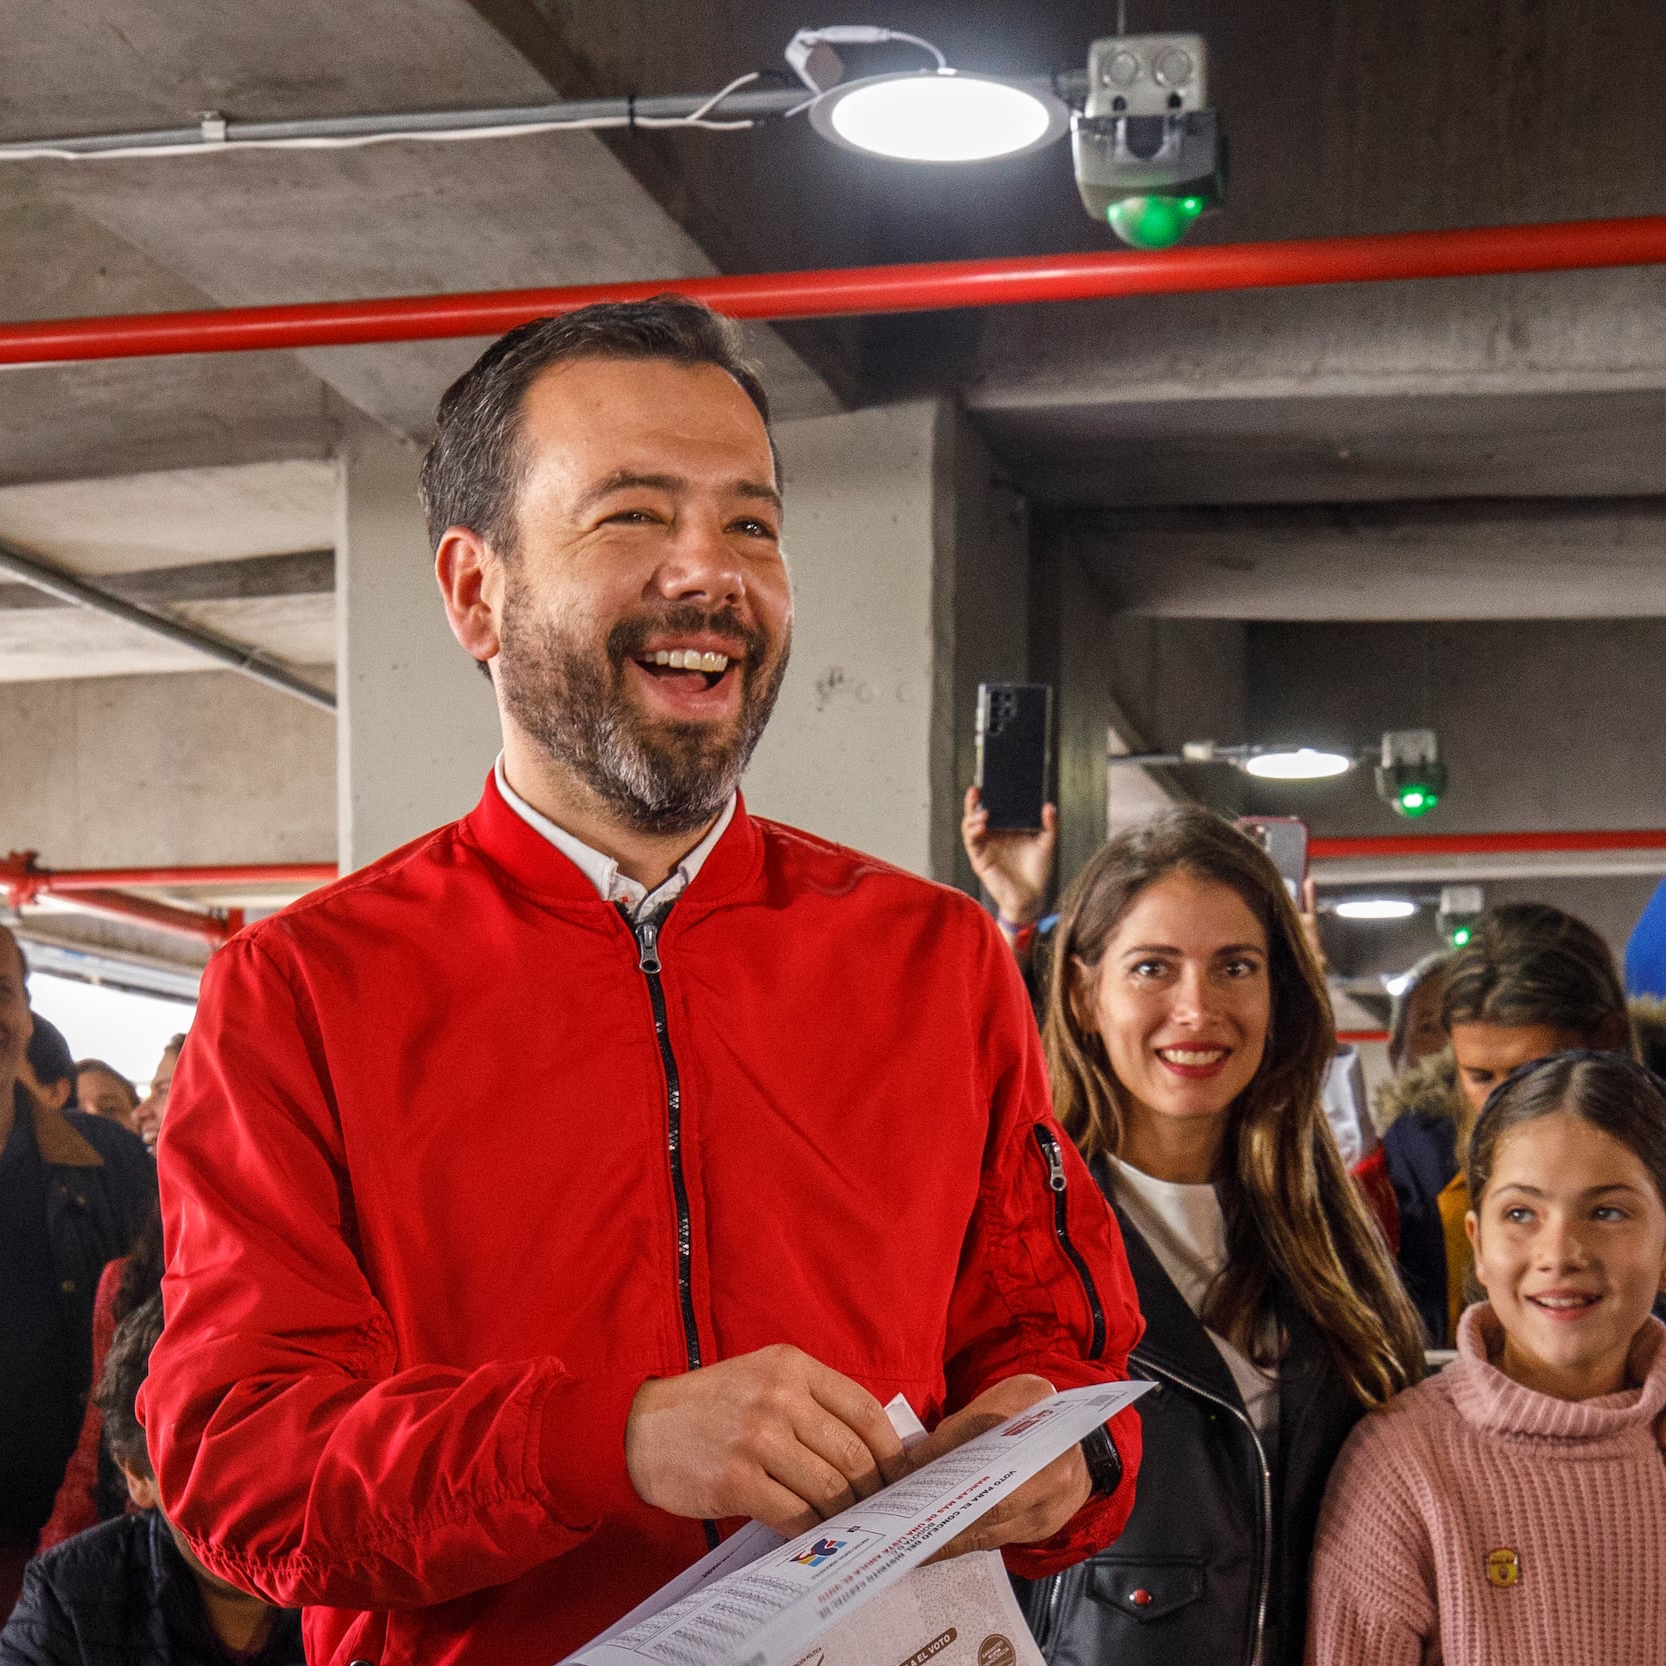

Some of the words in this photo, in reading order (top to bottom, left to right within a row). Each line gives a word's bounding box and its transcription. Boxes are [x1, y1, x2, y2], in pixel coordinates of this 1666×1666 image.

[971, 1485, 994, 1504] PARA
[959, 1502, 972, 1513] EL
[906, 1521, 925, 1537] UNA
[921, 1510, 960, 1541] CONCEJO
[916, 1650, 930, 1663] EL
[927, 1633, 952, 1654] VOTO
